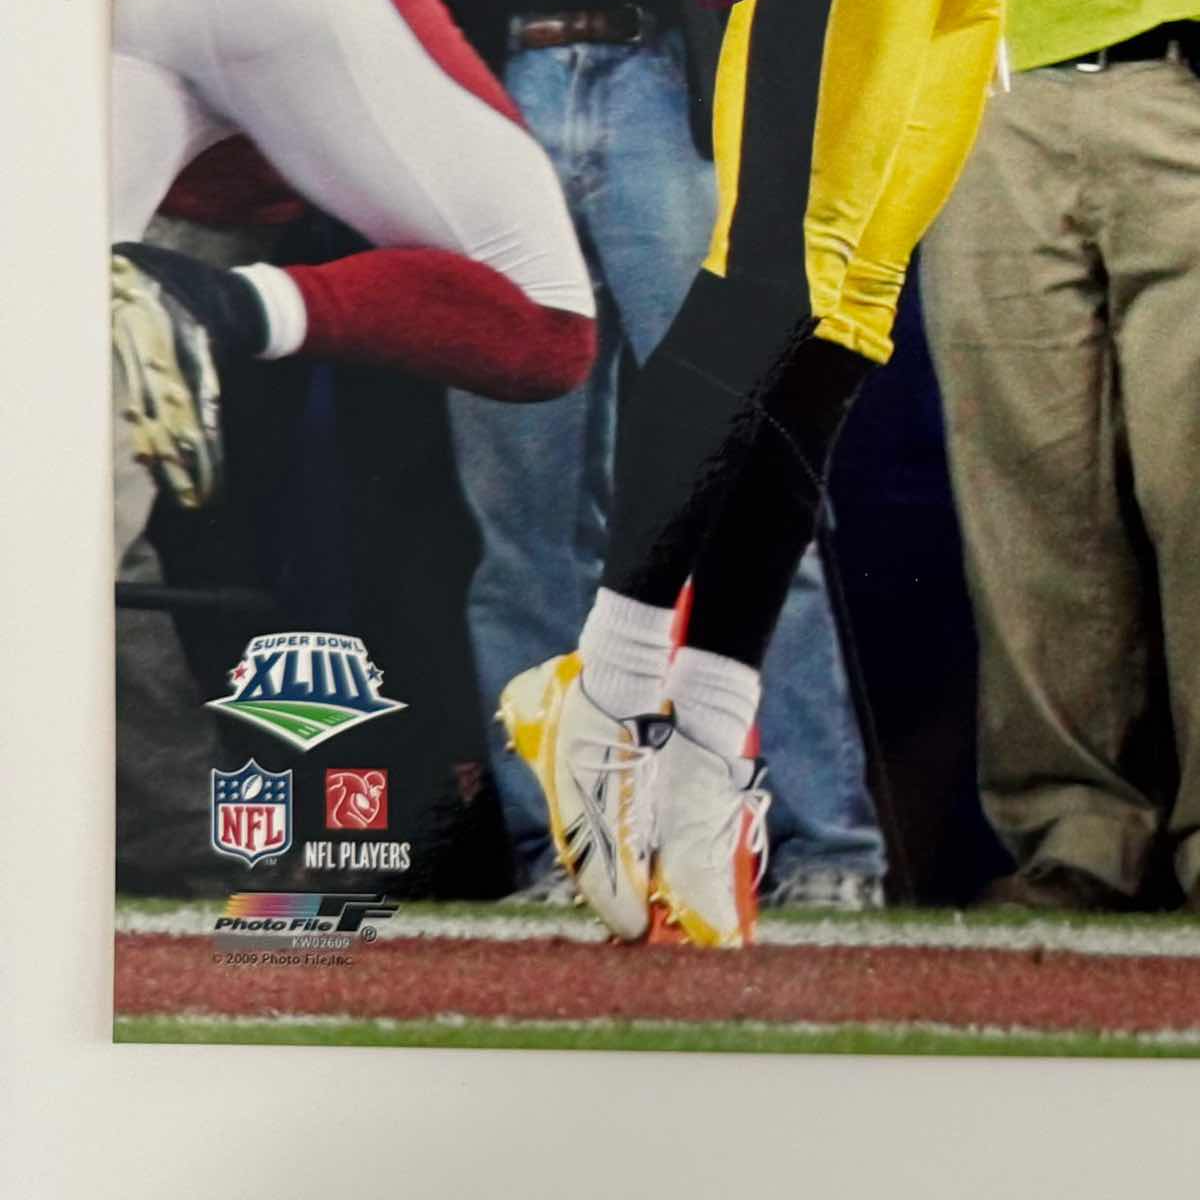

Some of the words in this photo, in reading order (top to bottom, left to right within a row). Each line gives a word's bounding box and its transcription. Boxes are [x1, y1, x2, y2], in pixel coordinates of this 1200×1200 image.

[252, 635, 309, 651] SUPER
[316, 635, 363, 652] BOWL
[238, 651, 378, 701] XLIII
[220, 805, 284, 849] NFL
[305, 842, 337, 869] NFL
[339, 842, 410, 870] PLAYERS
[215, 918, 286, 931] Photo
[288, 918, 334, 932] File
[226, 953, 257, 964] 2009
[262, 953, 300, 965] Photo
